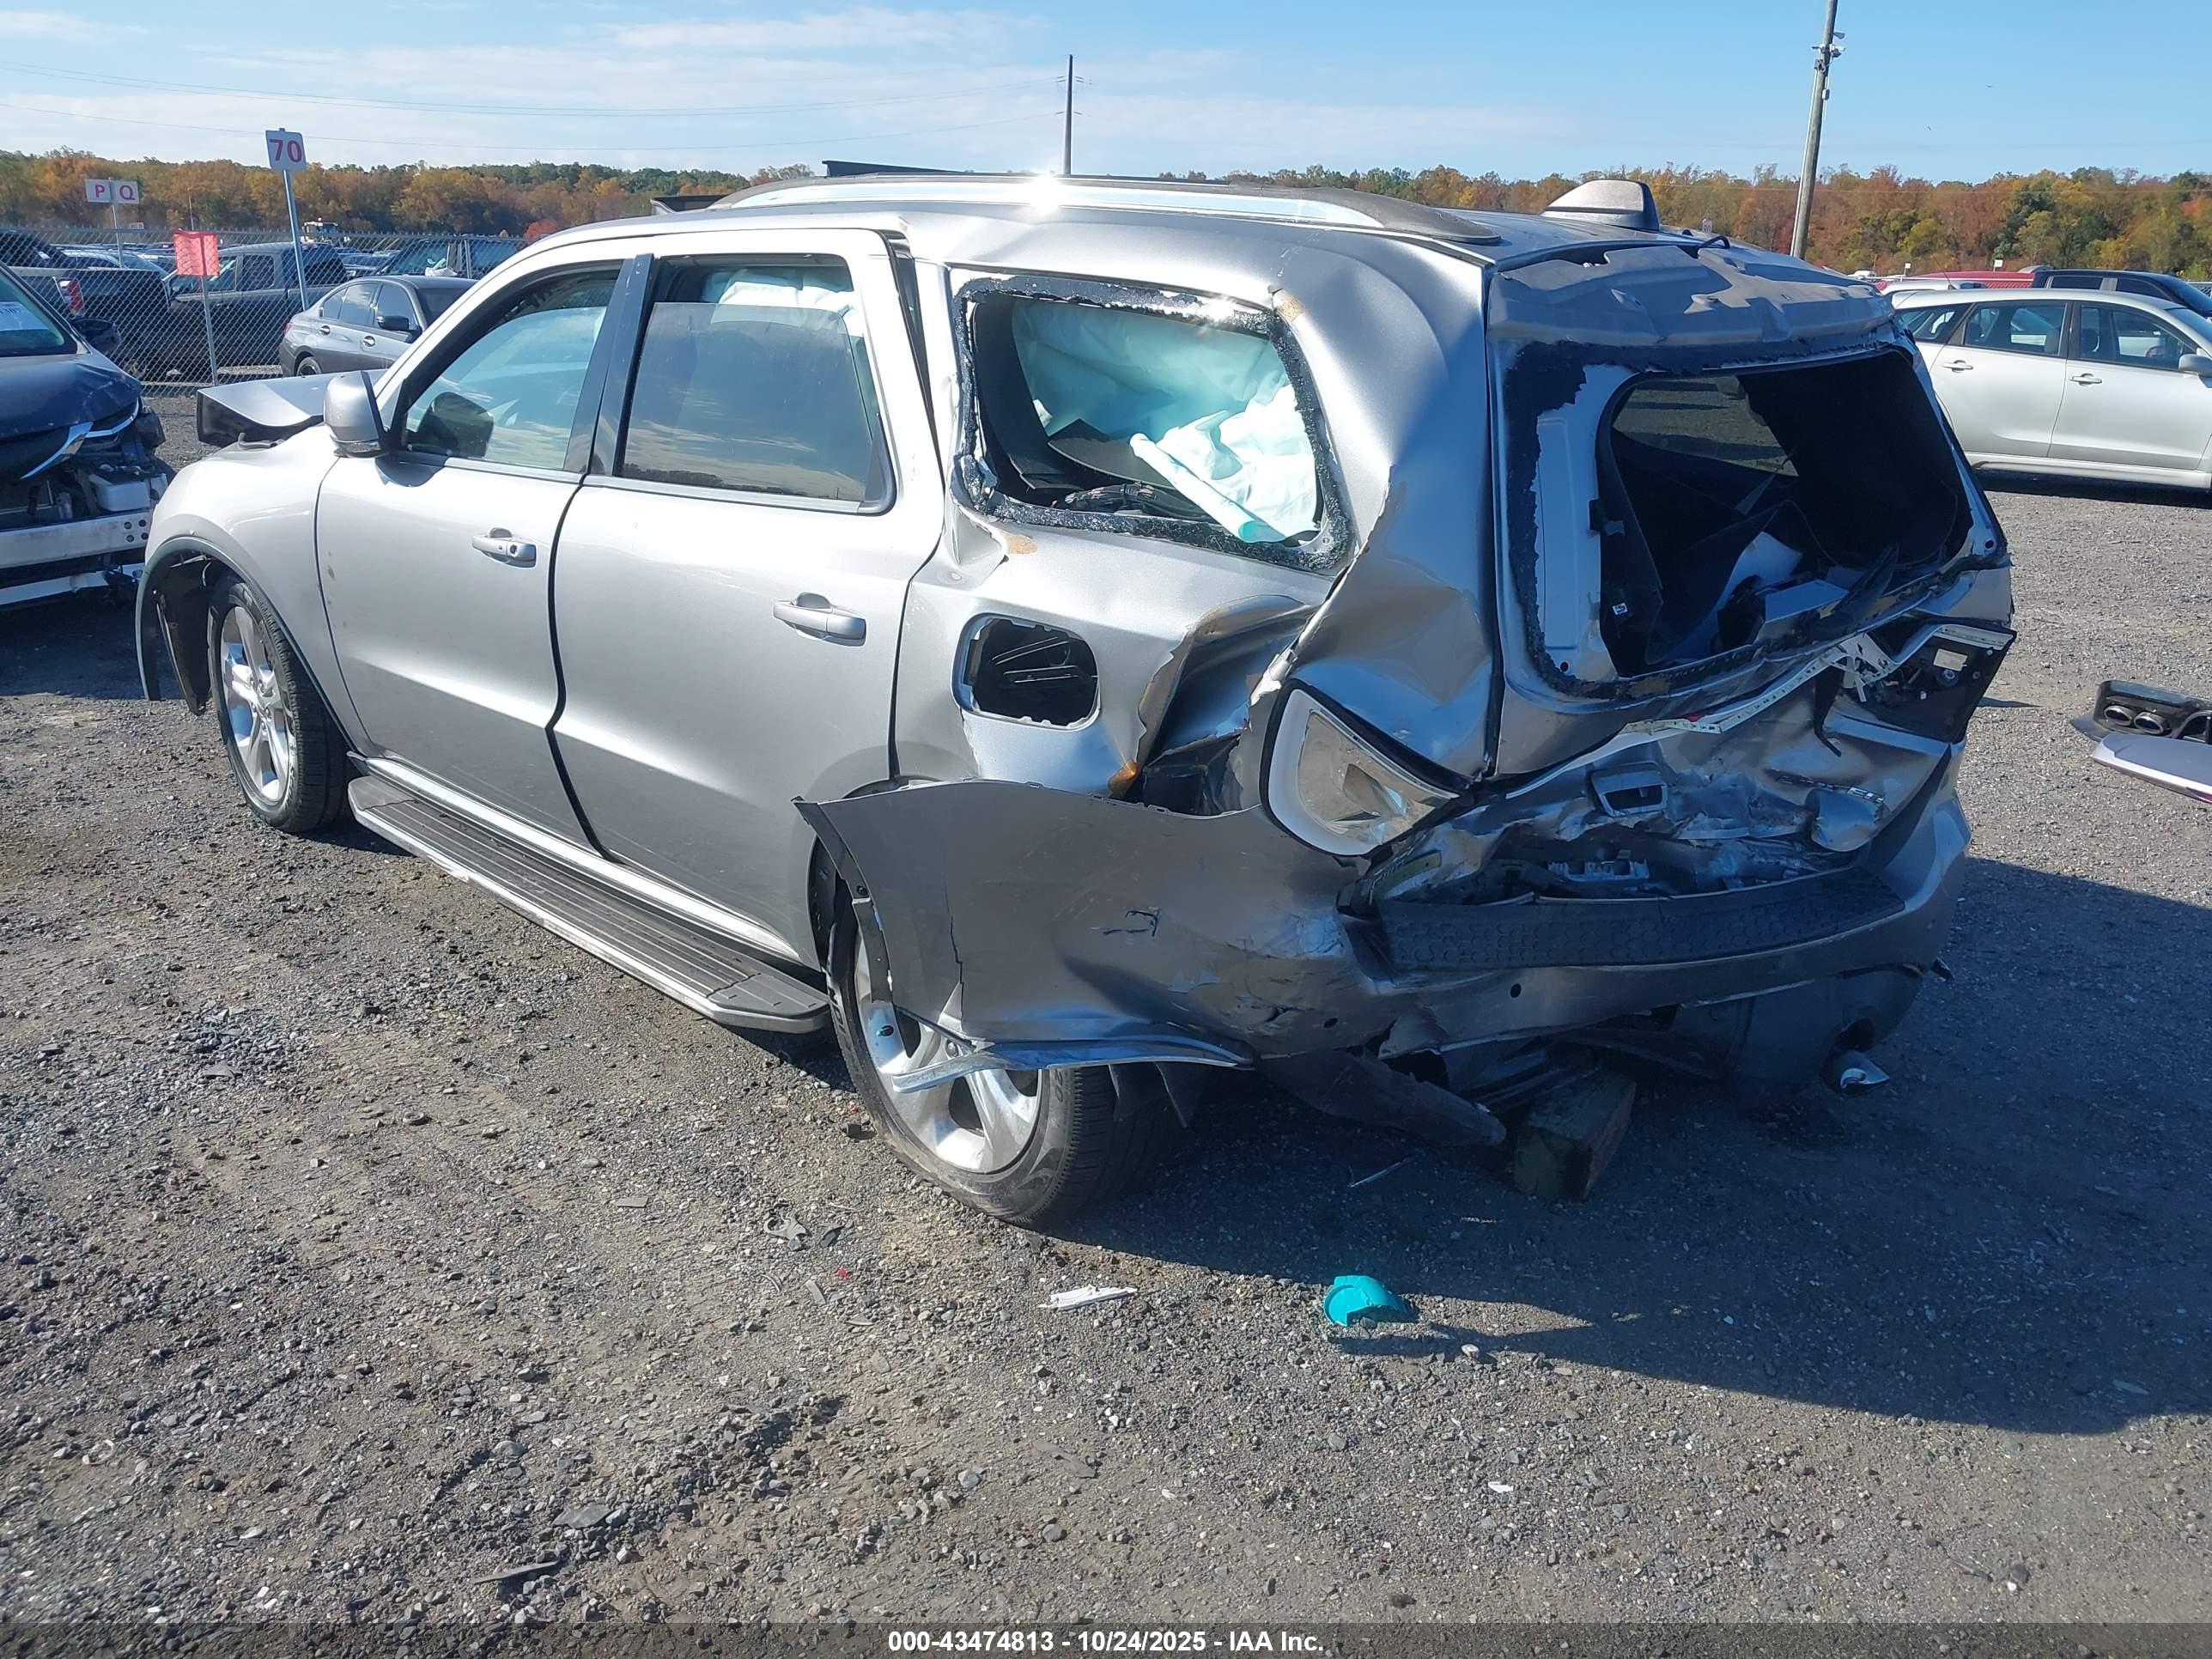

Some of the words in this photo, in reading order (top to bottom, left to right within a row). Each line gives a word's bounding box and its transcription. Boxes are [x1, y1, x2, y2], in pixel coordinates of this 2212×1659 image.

[269, 138, 303, 163] 70
[94, 184, 106, 198] P
[118, 185, 136, 201] Q
